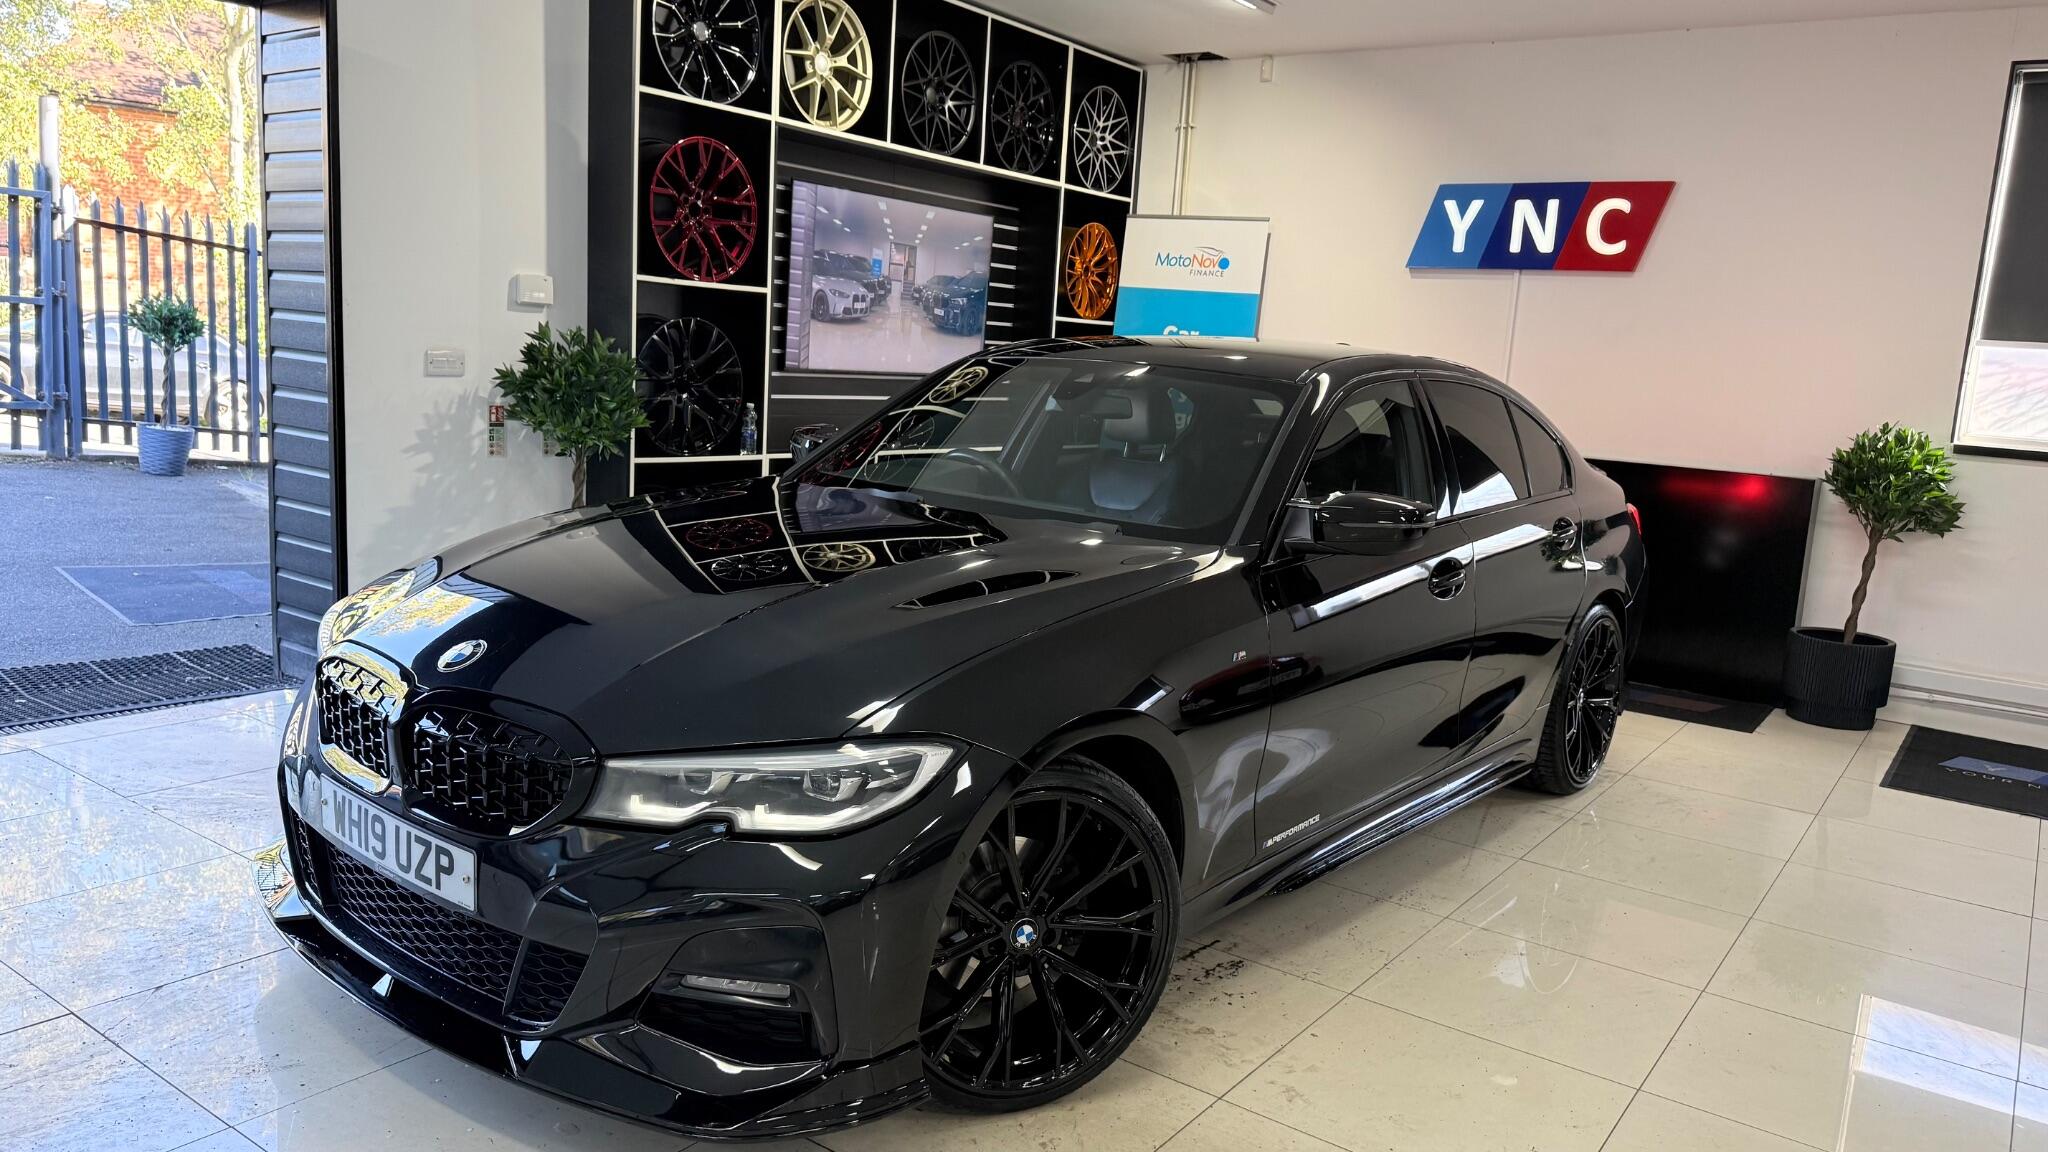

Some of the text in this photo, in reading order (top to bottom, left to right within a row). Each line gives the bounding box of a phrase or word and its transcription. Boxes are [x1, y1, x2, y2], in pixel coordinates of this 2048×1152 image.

[1443, 197, 1632, 256] YNC
[1189, 269, 1225, 278] FINANCE
[1945, 767, 2013, 784] YOUR
[333, 789, 455, 892] WH19 UZP
